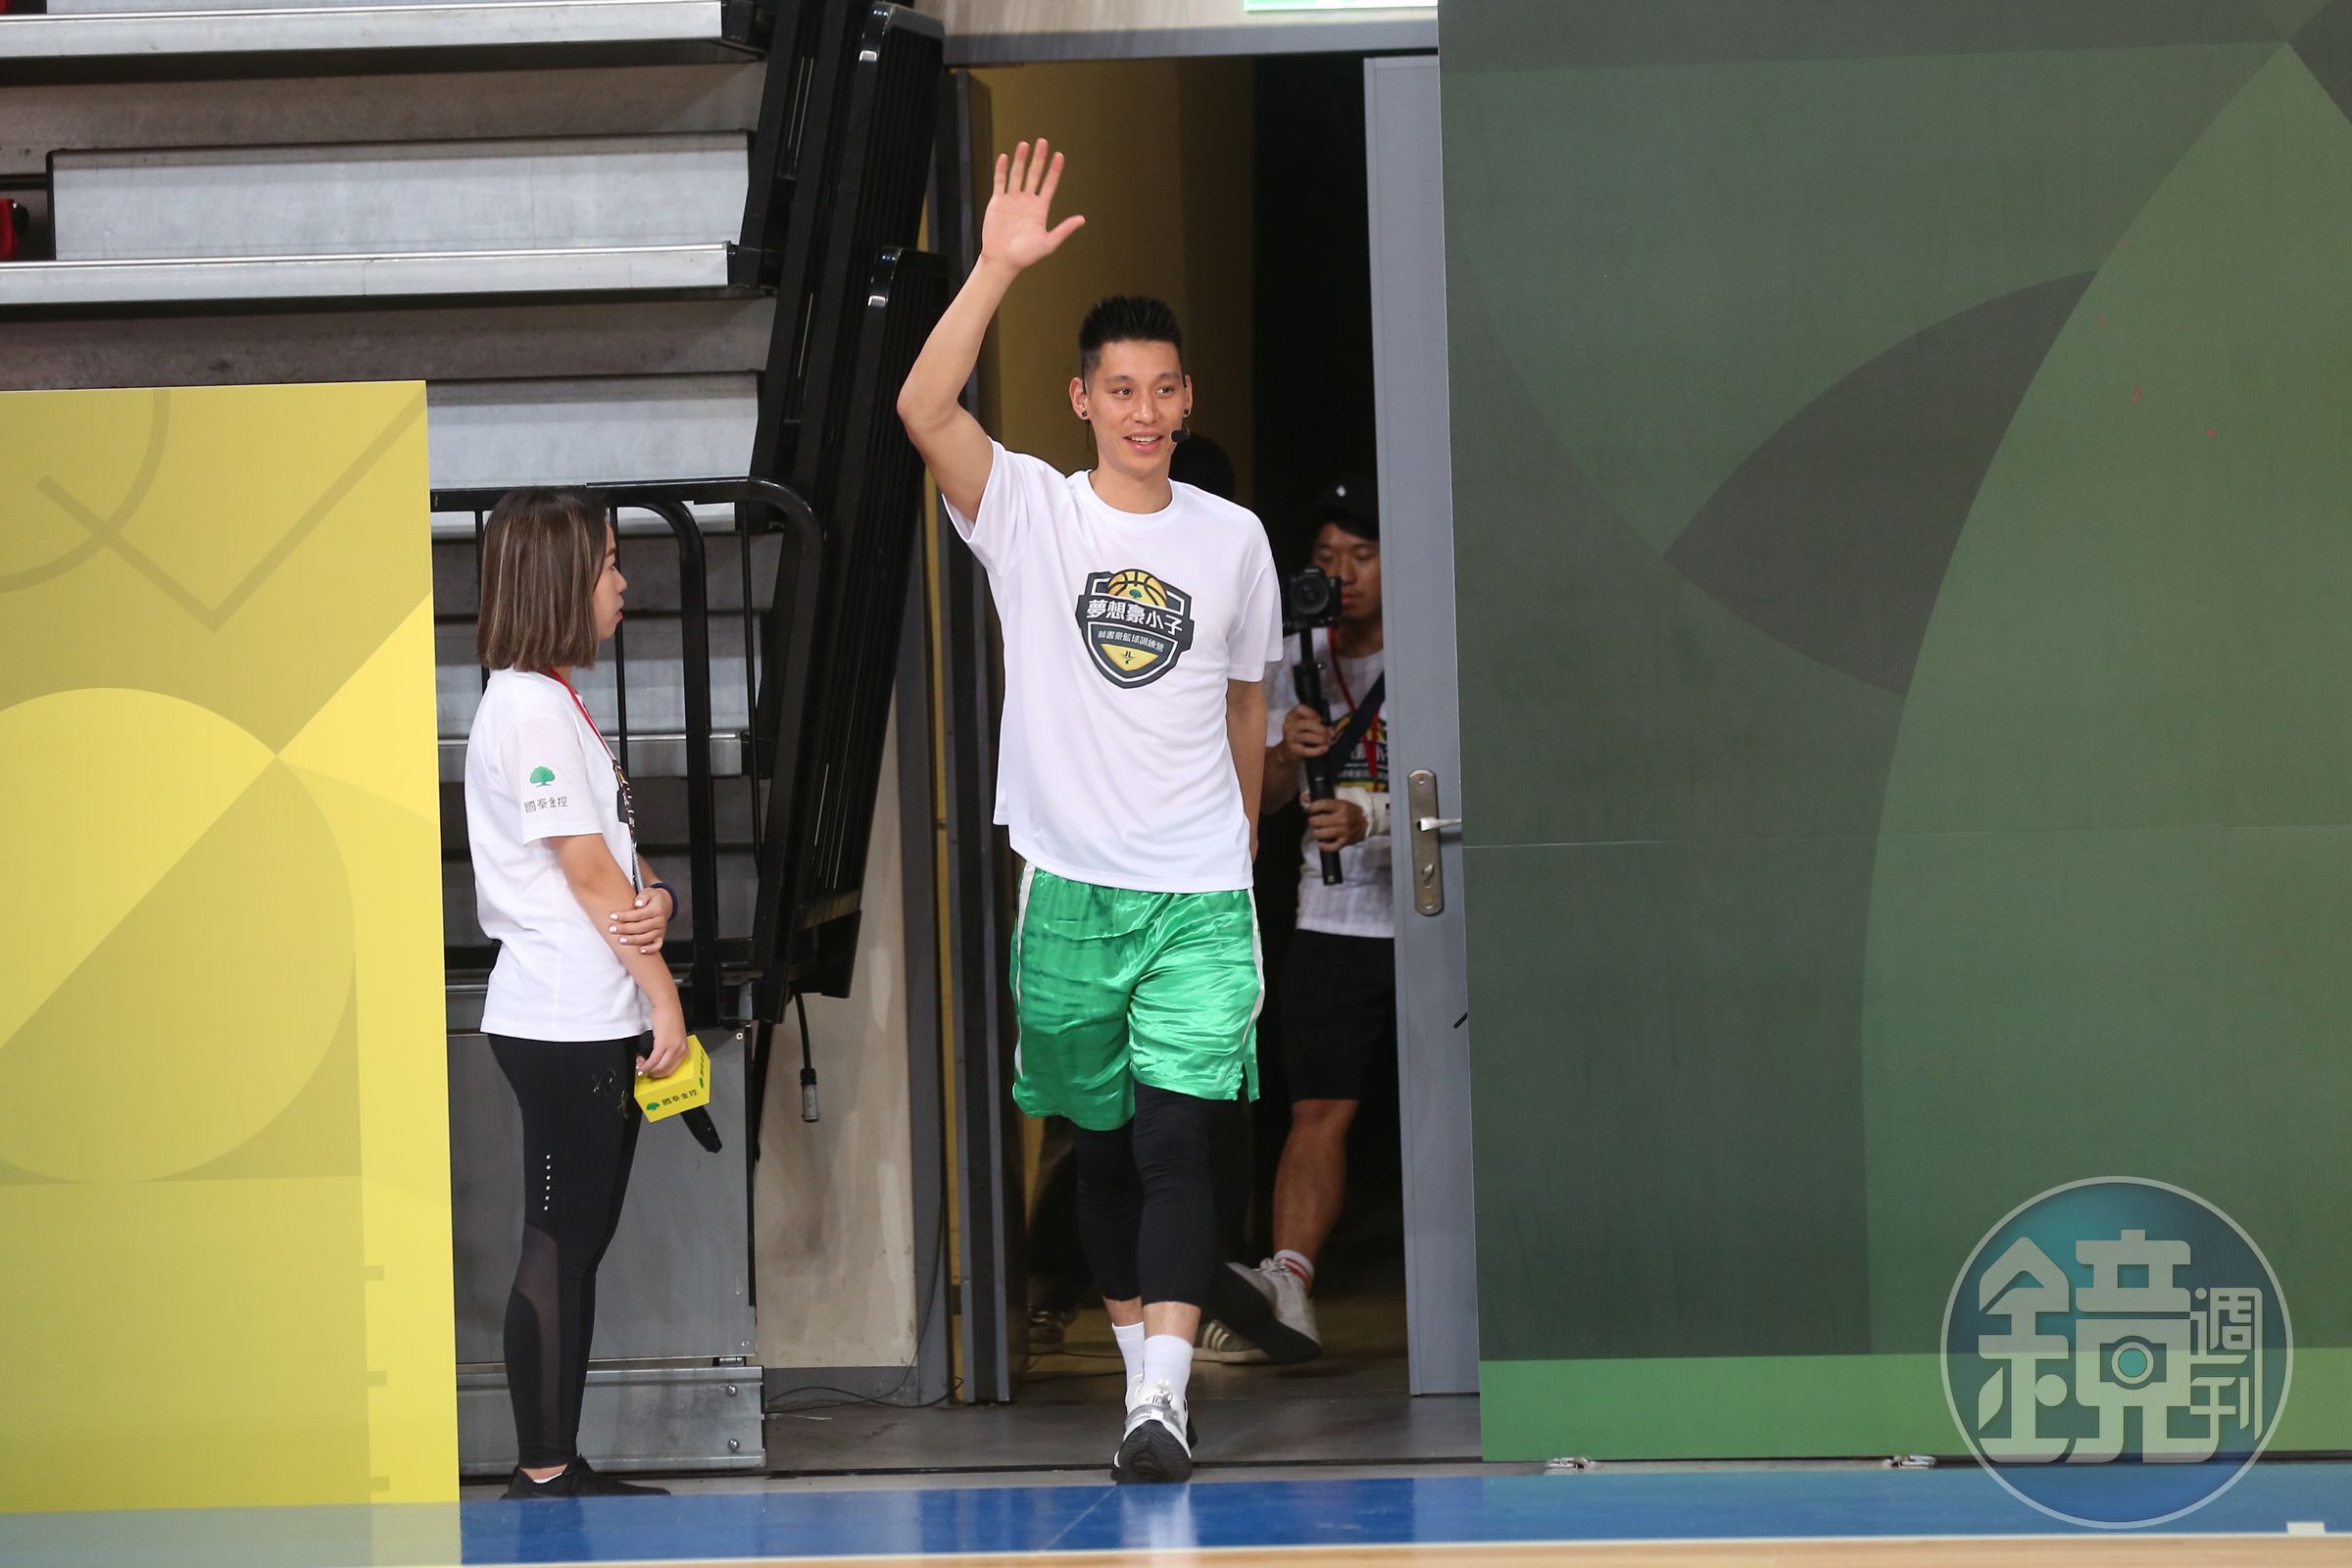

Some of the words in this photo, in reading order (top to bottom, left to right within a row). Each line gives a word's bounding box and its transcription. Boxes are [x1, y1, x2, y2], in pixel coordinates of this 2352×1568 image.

[1087, 599, 1183, 636] 夢想豪小子
[523, 796, 568, 813] 國泰金控
[662, 1089, 698, 1106] 國泰金控
